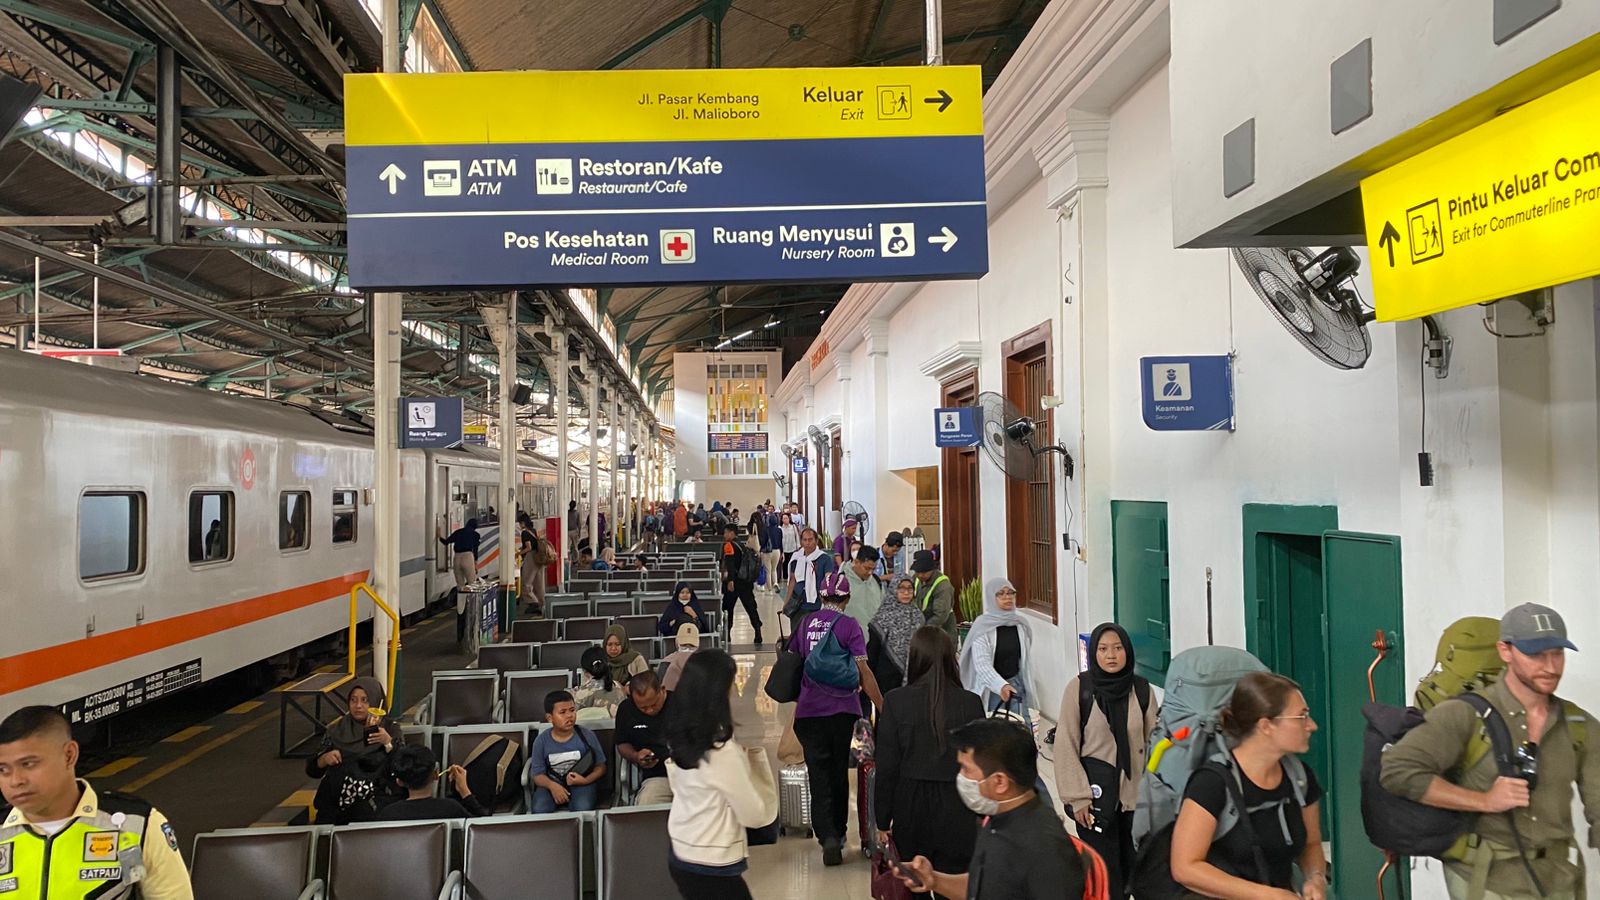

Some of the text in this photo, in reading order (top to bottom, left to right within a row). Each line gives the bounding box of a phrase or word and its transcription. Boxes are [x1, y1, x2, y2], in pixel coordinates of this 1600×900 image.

[638, 93, 760, 108] Jl. Pasar Kembang
[803, 86, 864, 103] Keluar
[673, 109, 760, 120] Jl. Malioboro
[841, 108, 864, 121] Exit
[468, 159, 517, 176] ATM
[579, 157, 723, 176] Restoran/Kafe
[467, 182, 502, 195] ATM
[579, 180, 688, 195] Restaurant/Cafe
[1448, 192, 1488, 220] Pintu
[1492, 170, 1548, 204] Keluar
[1453, 226, 1470, 244] Exit
[1473, 222, 1487, 238] for
[1490, 196, 1570, 232] Commuterline
[504, 230, 649, 248] Pos Kesehatan
[713, 223, 873, 246] Ruang Menyusui
[551, 252, 649, 266] Medical Room
[782, 246, 875, 261] Nursery Room
[81, 869, 119, 879] SATPAM
